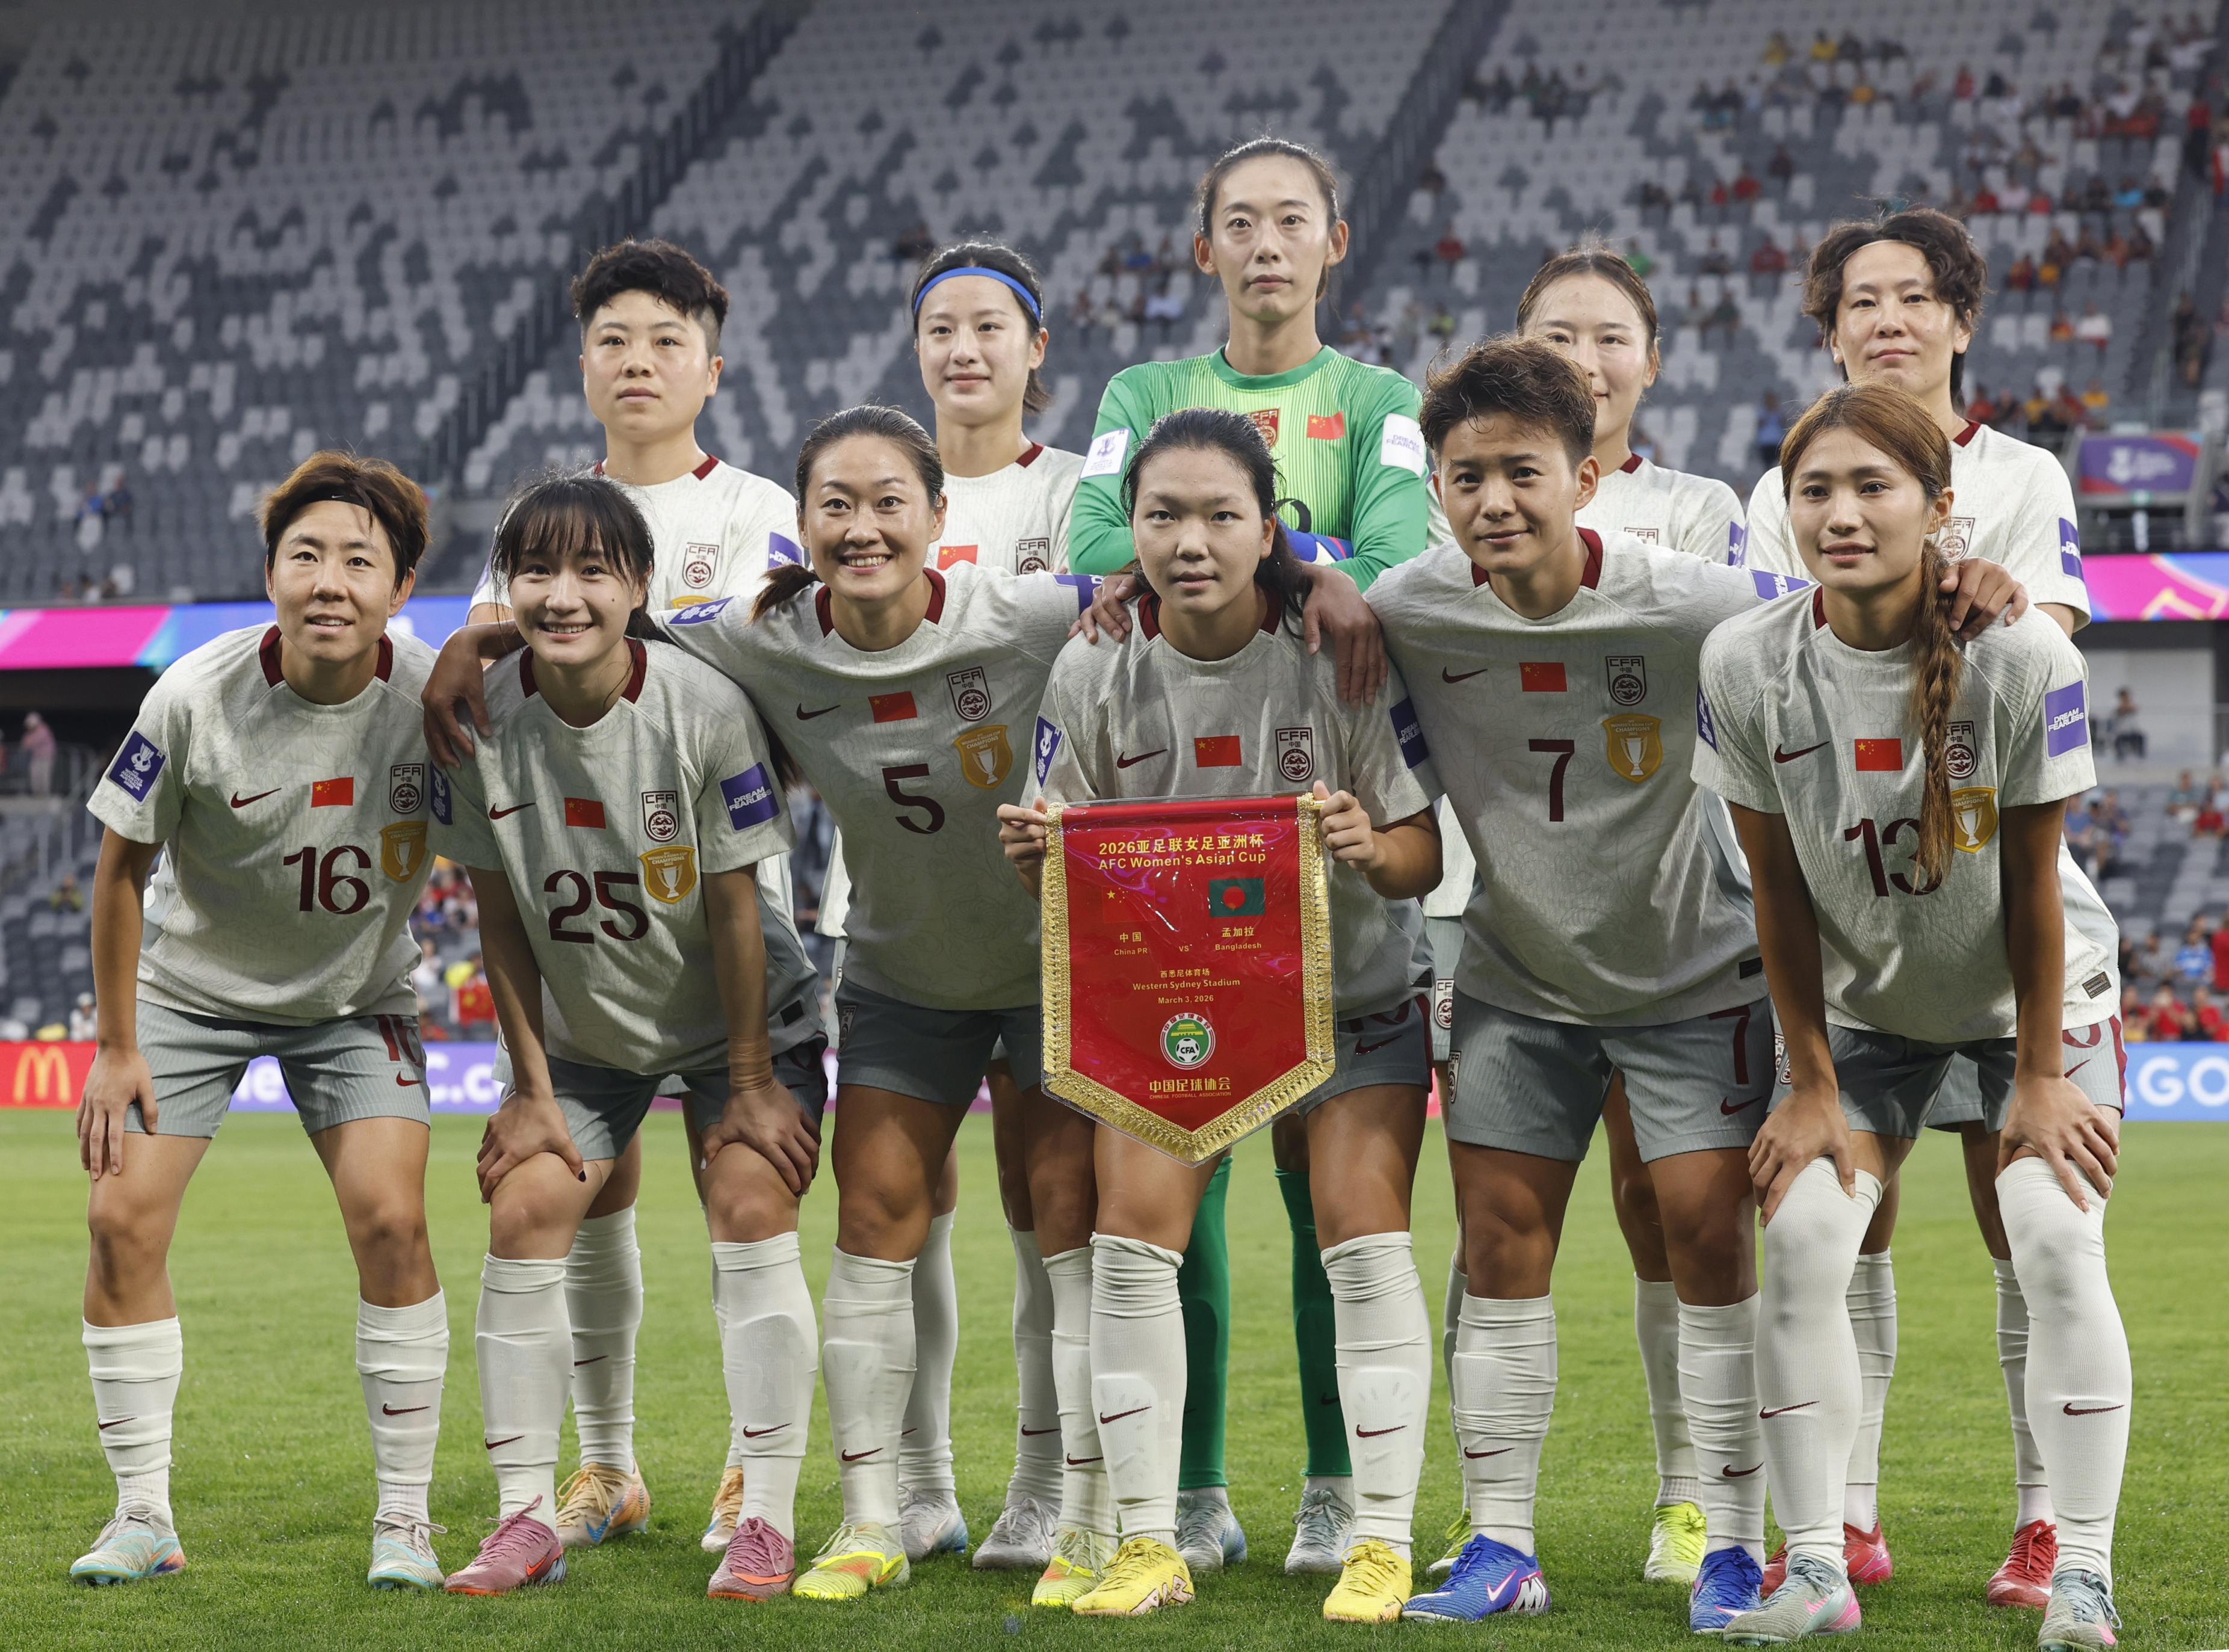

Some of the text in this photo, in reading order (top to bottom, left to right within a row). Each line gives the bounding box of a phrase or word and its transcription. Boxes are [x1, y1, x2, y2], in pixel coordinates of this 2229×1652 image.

[688, 546, 716, 555] CFA
[1019, 541, 1046, 550] CFA
[950, 670, 982, 685] CFA
[2048, 712, 2084, 732] FEARLESS
[2053, 707, 2079, 723] DREAM
[966, 735, 999, 749] CHAMPIONS
[1279, 731, 1309, 741] CFA
[393, 767, 421, 777] CFA
[1529, 739, 1575, 822] 7
[645, 794, 675, 804] CFA
[729, 789, 772, 812] FEARLESS
[734, 786, 765, 804] DREAM
[882, 763, 945, 834] 5
[1953, 798, 1985, 807] HAMPIONS
[1098, 833, 1264, 855] 2026亚足联女足亚洲杯
[652, 855, 684, 865] CHAMPIONS
[1098, 851, 1266, 870] AFC Women's Asian Cup
[1844, 818, 1943, 896] 13
[283, 845, 372, 914] 16
[544, 869, 650, 944] 25
[1119, 932, 1142, 943] 中国
[1222, 926, 1254, 937] 孟加拉
[1215, 942, 1262, 951] Bangladesh
[1160, 968, 1210, 978] 西悉尼体育场
[1170, 981, 1201, 990] Sydney
[1204, 979, 1240, 987] Stadium
[1437, 982, 1452, 991] CF
[1708, 1005, 1751, 1085] 7
[1149, 1077, 1231, 1093] 中国足球协会
